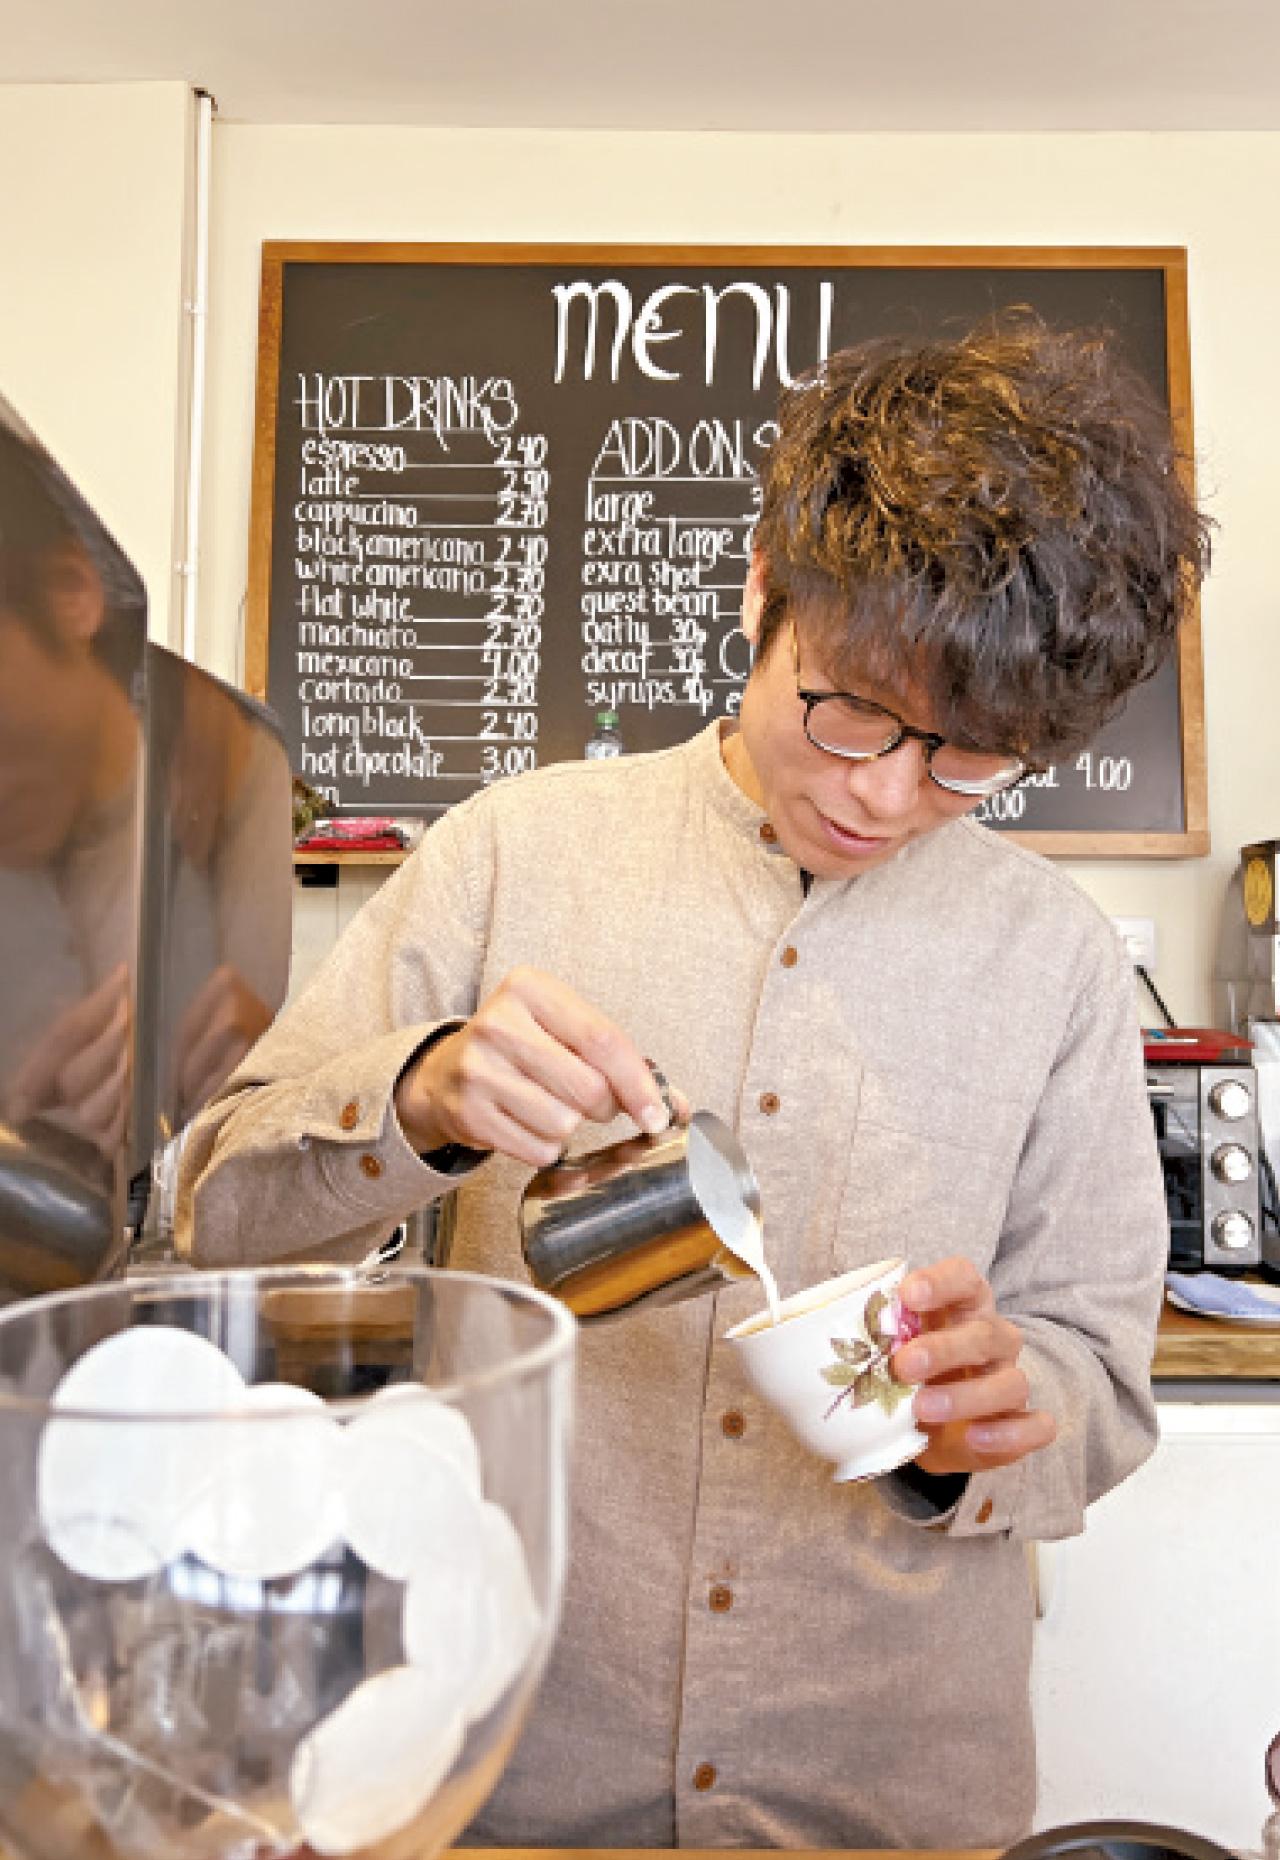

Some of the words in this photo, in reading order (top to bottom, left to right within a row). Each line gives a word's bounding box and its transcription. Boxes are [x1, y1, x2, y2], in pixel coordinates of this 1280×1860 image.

[293, 373, 374, 437] HOT
[375, 376, 518, 450] DRINKS
[302, 438, 406, 472] espresso
[591, 417, 681, 477] ADD
[302, 466, 360, 496] latte
[294, 500, 417, 534] cappuccino
[586, 478, 655, 528] large
[296, 524, 363, 564] black
[365, 530, 485, 567] americano
[583, 523, 660, 556] extra
[668, 515, 734, 572] large
[295, 557, 363, 586] white
[365, 560, 485, 597] americano
[648, 558, 701, 592] shot
[296, 585, 343, 618] flat
[352, 588, 413, 625] white
[581, 587, 649, 620] guest
[651, 587, 719, 621] bean
[295, 651, 414, 679] mexicano
[581, 645, 655, 680] decaf
[298, 677, 403, 704] cortado
[585, 679, 676, 711] syrups
[302, 705, 360, 744] long
[362, 705, 425, 742] black
[478, 710, 538, 740] 2.40
[302, 742, 341, 777] hot
[343, 742, 445, 787] chocolate
[1075, 752, 1133, 791] 4.00
